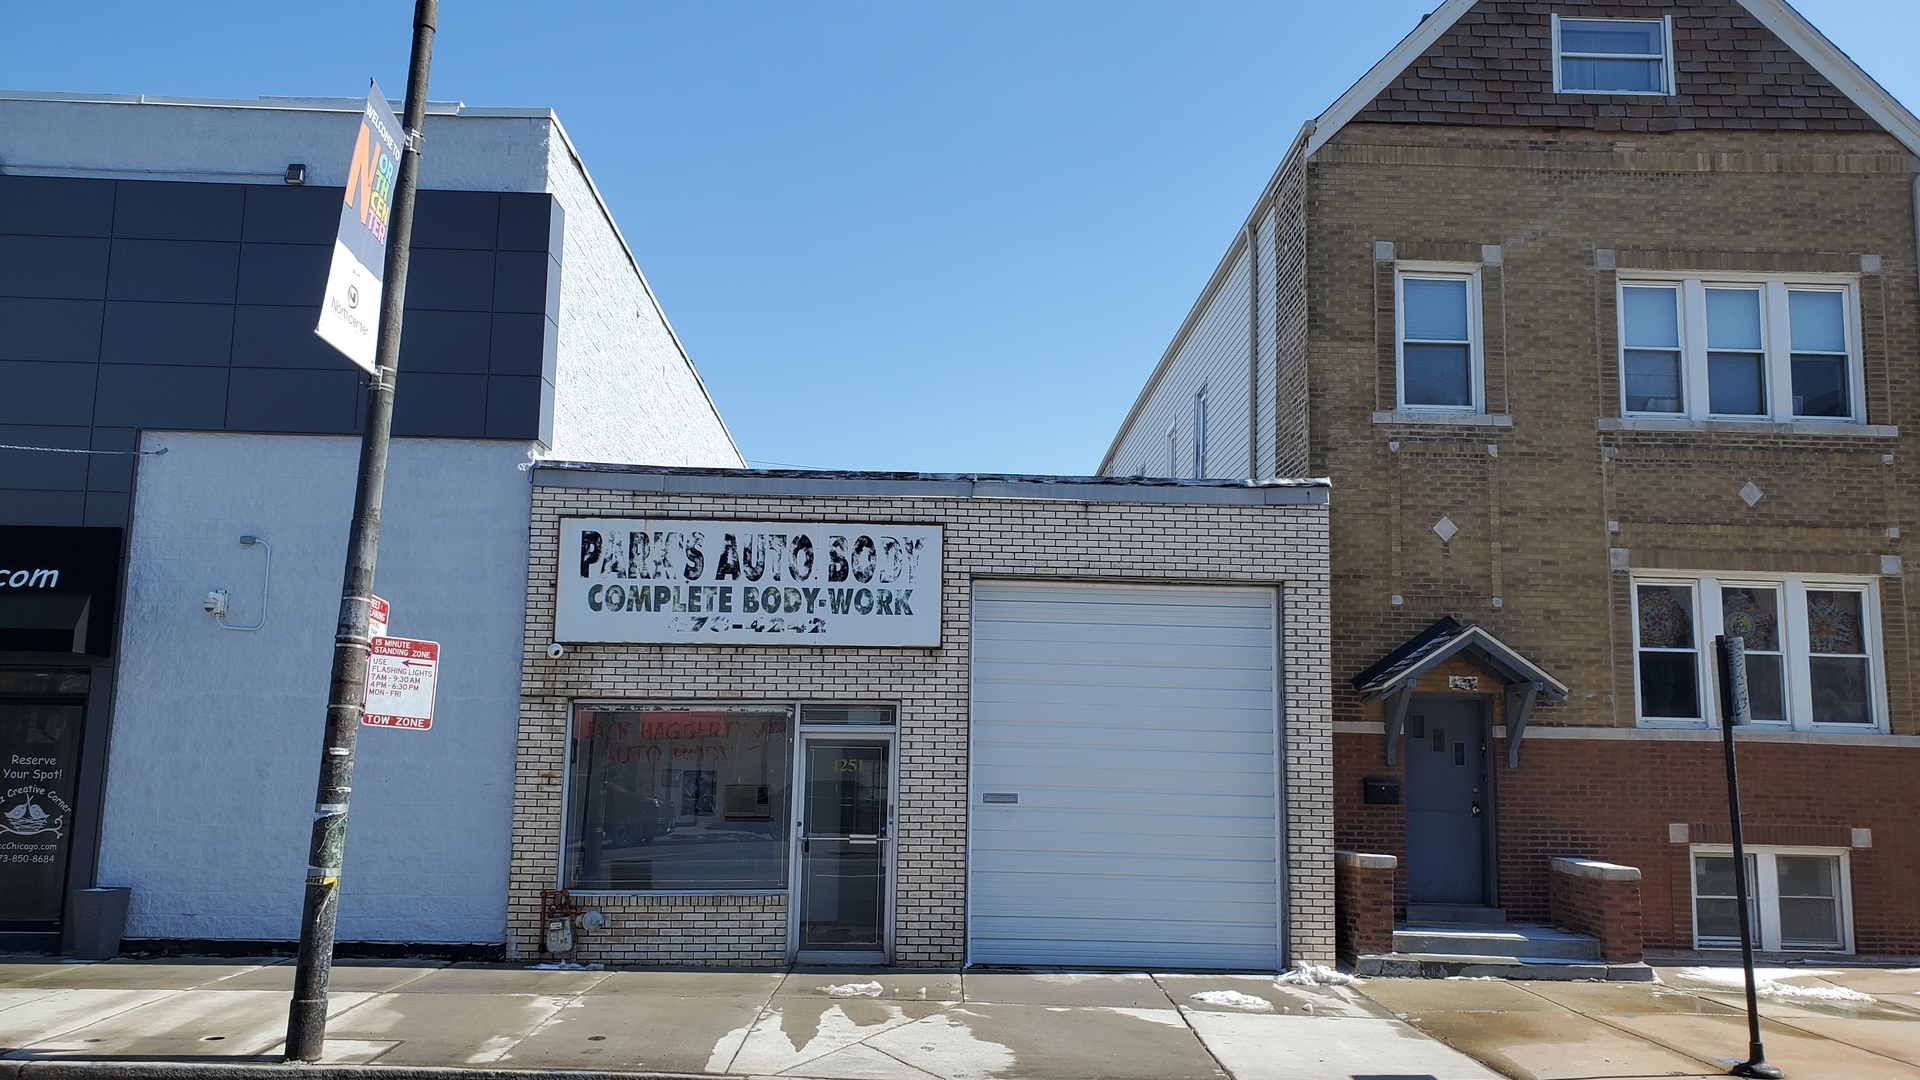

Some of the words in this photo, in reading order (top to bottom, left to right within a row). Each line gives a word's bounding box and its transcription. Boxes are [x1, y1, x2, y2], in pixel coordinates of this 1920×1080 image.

[367, 102, 393, 150] WELCOME
[392, 143, 400, 162] TO
[715, 532, 815, 582] AUTO
[827, 535, 927, 584] BODY
[587, 584, 733, 613] COMPLETE
[743, 586, 915, 616] BODY-WORK
[668, 615, 827, 634] 7-4242
[384, 640, 411, 649] MINUTE
[374, 646, 409, 656] STANDING
[411, 650, 431, 659] ZONE
[371, 665, 407, 675] FLASHING
[408, 669, 433, 678] LIGHTS
[369, 688, 385, 696] MON
[367, 714, 390, 725] TOW
[395, 717, 425, 728] ZONE
[11, 754, 57, 765] Reserve
[601, 745, 663, 765] AUTO
[3, 768, 30, 779] Your
[32, 768, 63, 782] Spot!
[7, 784, 46, 798] Creative
[47, 790, 72, 814] Corner
